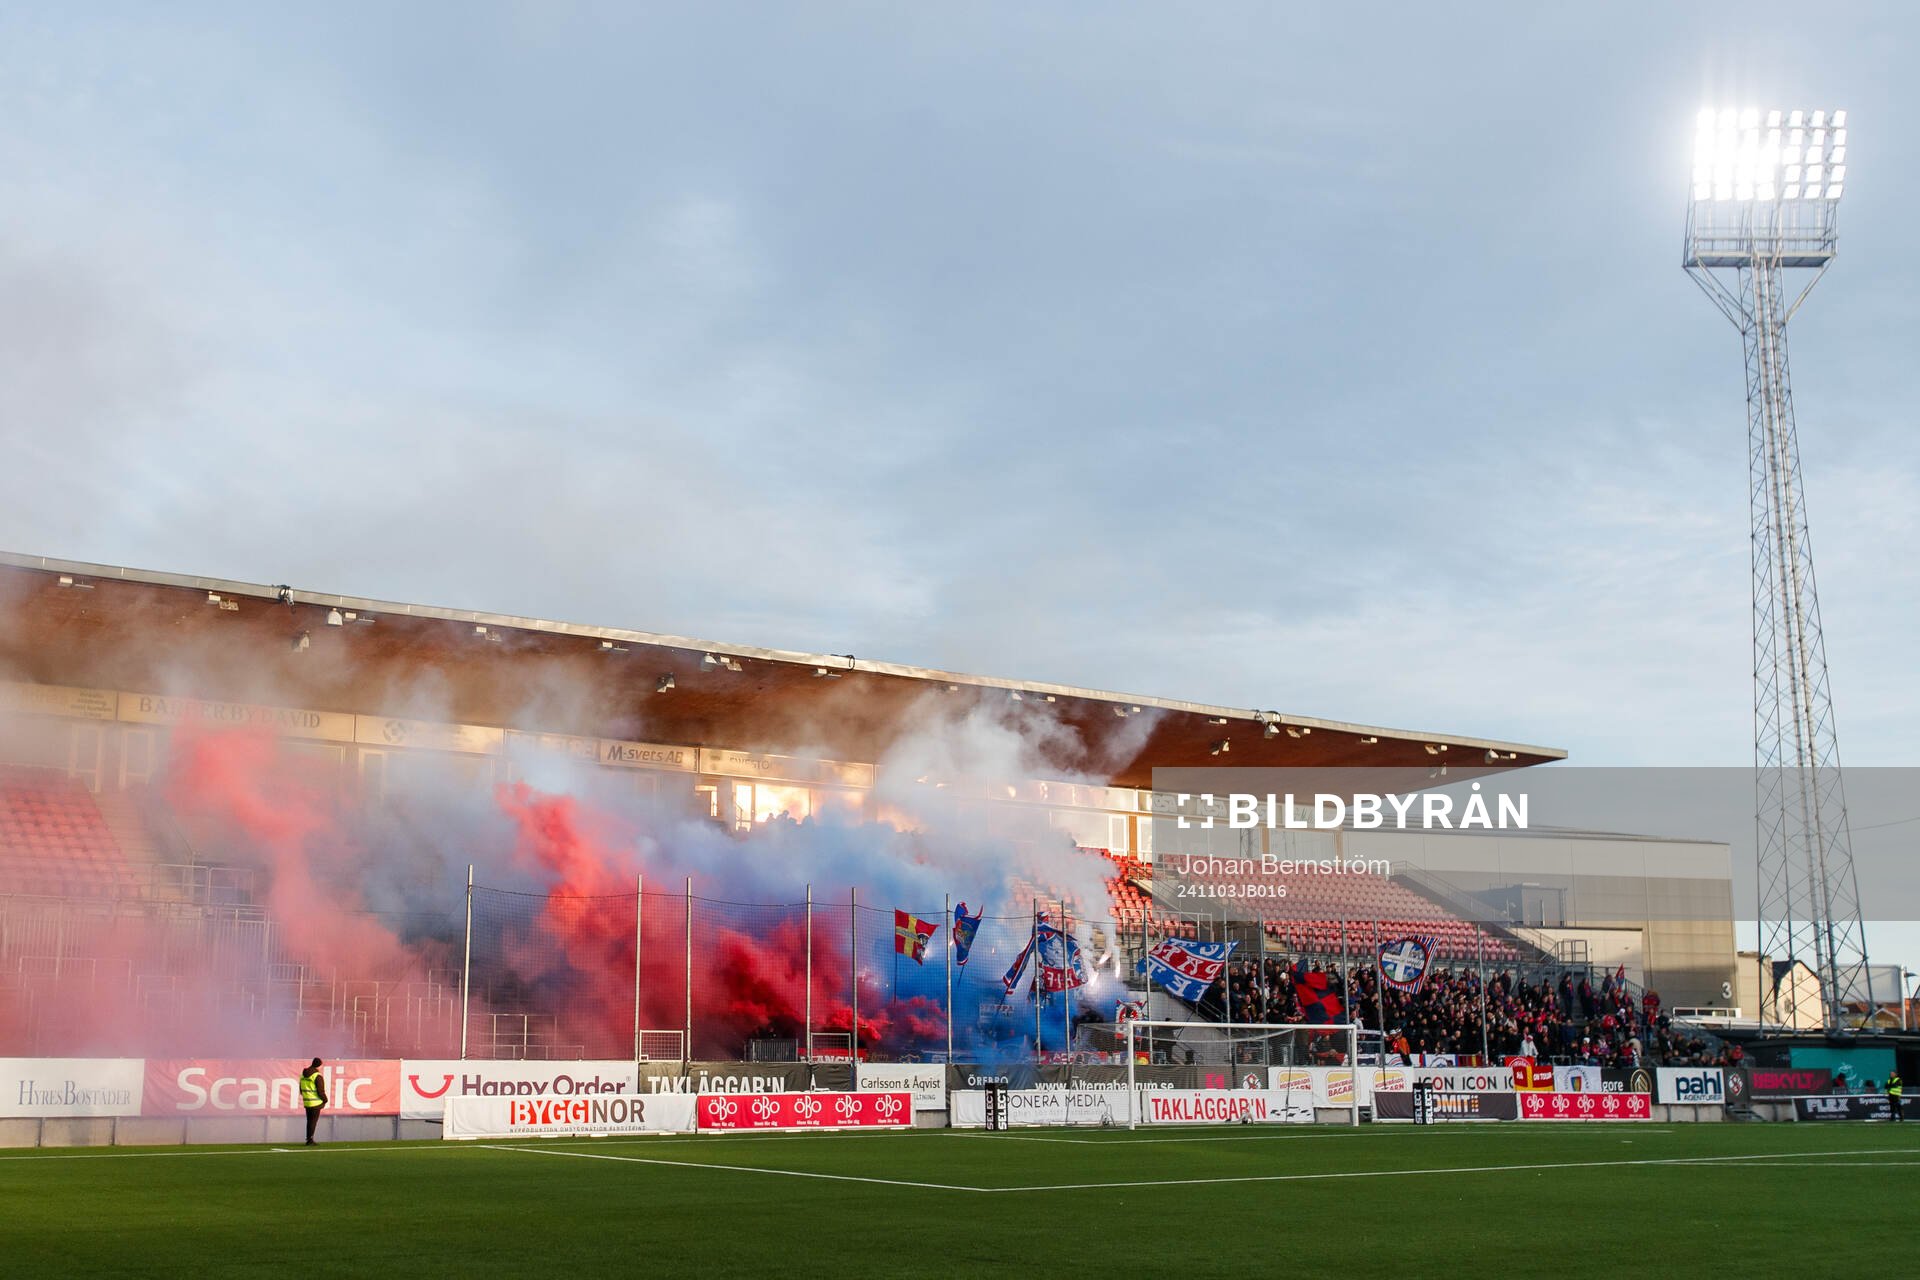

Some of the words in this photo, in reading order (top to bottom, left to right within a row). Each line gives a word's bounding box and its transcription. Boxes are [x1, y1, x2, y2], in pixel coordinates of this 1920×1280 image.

[665, 750, 684, 764] AB
[1722, 981, 1732, 999] 3
[462, 1075, 548, 1096] Happy
[553, 1075, 626, 1095] Order
[861, 1077, 901, 1089] Carlsson
[904, 1078, 910, 1089] &
[912, 1075, 941, 1093] Åqvist
[1462, 1076, 1497, 1090] ICON
[1602, 1081, 1624, 1093] gore
[1676, 1071, 1722, 1101] pahl
[511, 1098, 646, 1125] BYGGNOR
[708, 1096, 738, 1120] ÖBO
[752, 1095, 781, 1120] ÖBO
[794, 1095, 822, 1119] ÖBO
[835, 1095, 862, 1118] ÖBO
[875, 1094, 902, 1117] ÖBO
[985, 1089, 994, 1130] SELECT
[998, 1088, 1007, 1130] SELECT
[1065, 1094, 1107, 1107] MEDIA
[1151, 1093, 1267, 1120] TAKLÄGGAR'N
[1414, 1088, 1423, 1124] SELECT
[1424, 1088, 1434, 1124] SELECT
[1806, 1098, 1850, 1113] FLEX
